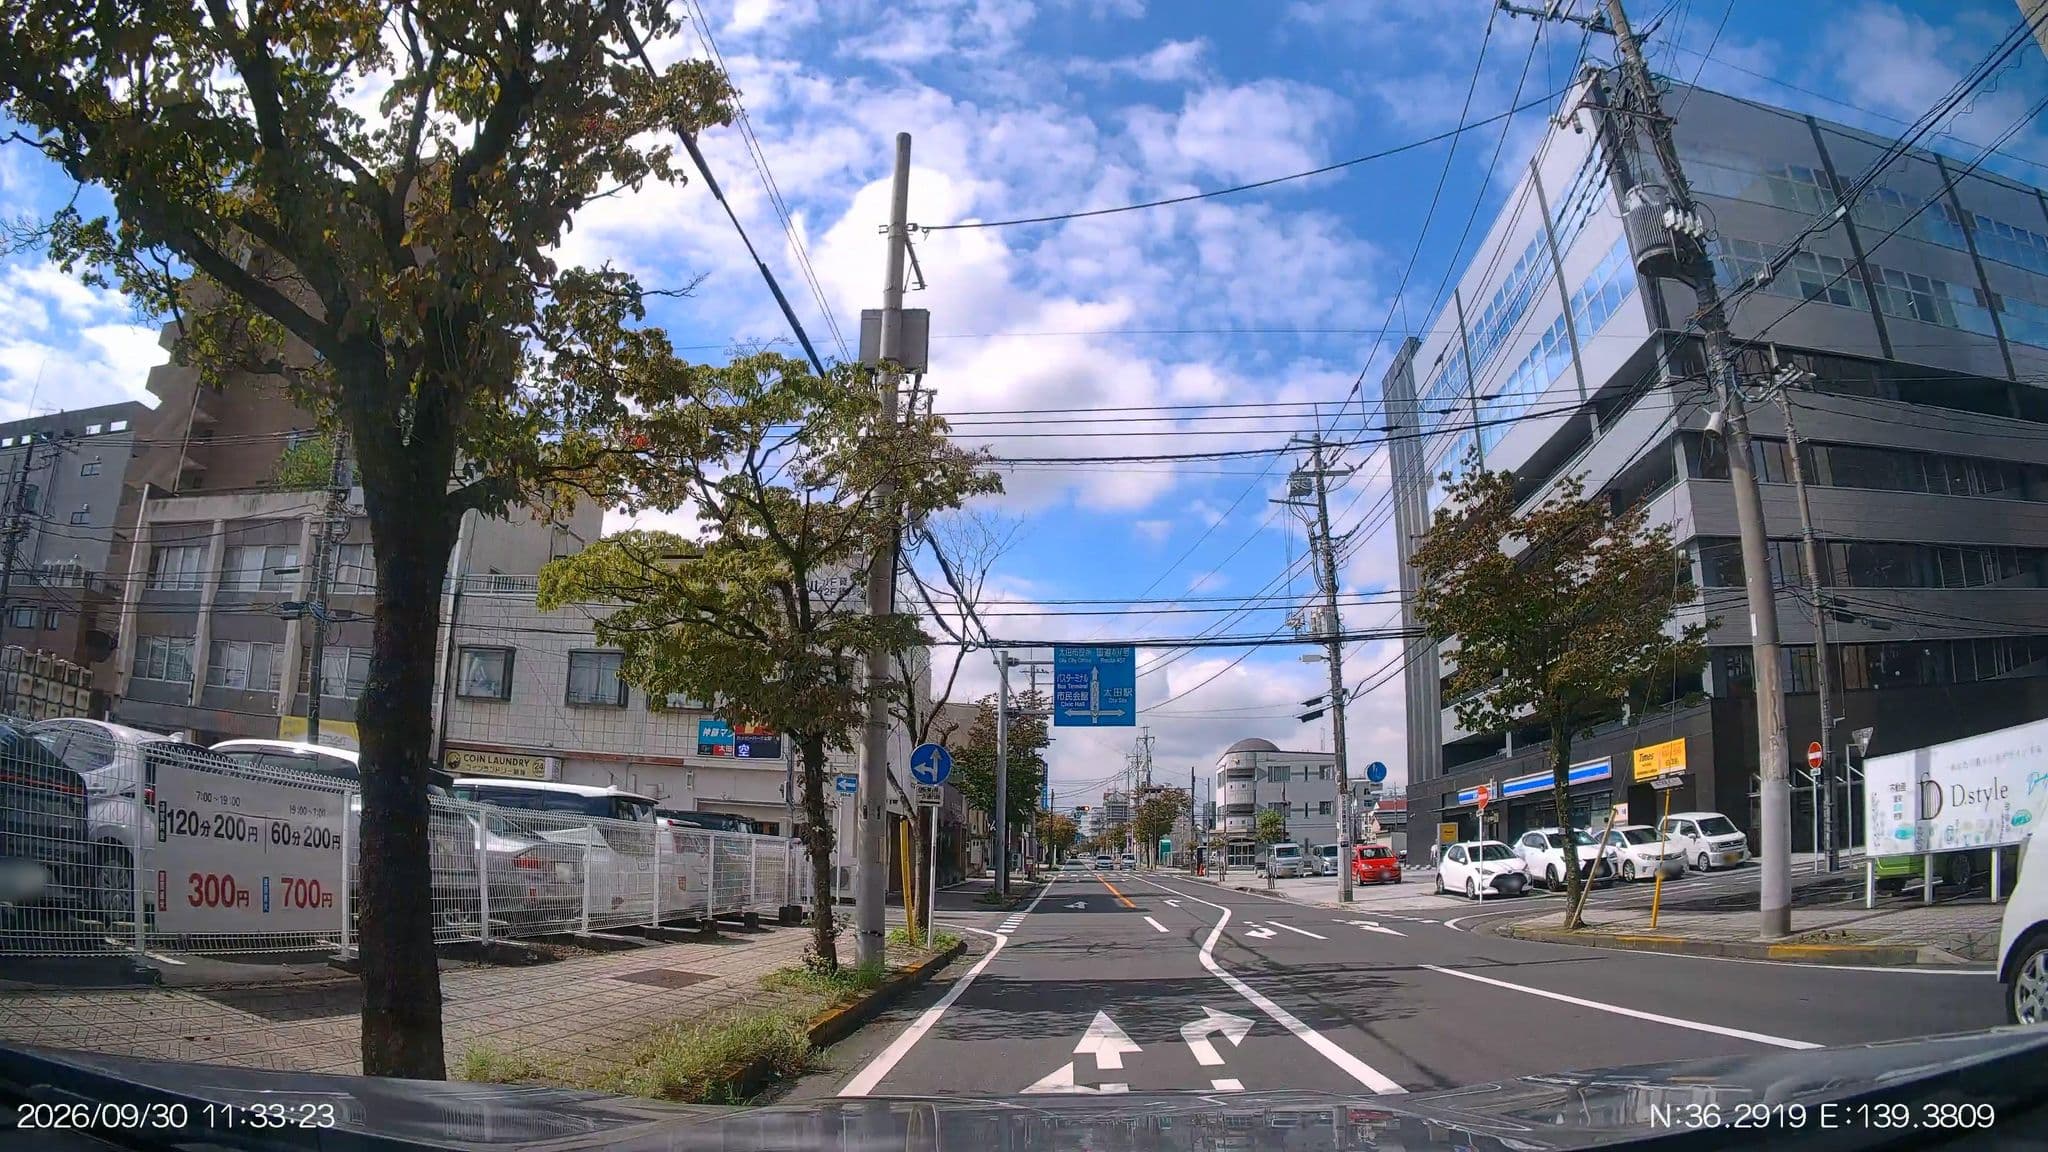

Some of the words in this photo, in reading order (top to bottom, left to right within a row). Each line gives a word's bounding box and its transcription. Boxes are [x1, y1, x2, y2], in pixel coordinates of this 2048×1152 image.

[1056, 674, 1089, 683] バスターミナル
[1056, 692, 1089, 701] 市民会館
[1104, 688, 1133, 697] 太田駅
[737, 744, 750, 757] 空
[463, 753, 486, 763] COIN
[487, 755, 530, 768] LAUNDRY
[533, 762, 544, 770] 24
[188, 872, 250, 909] 300円
[281, 876, 333, 909] 700円
